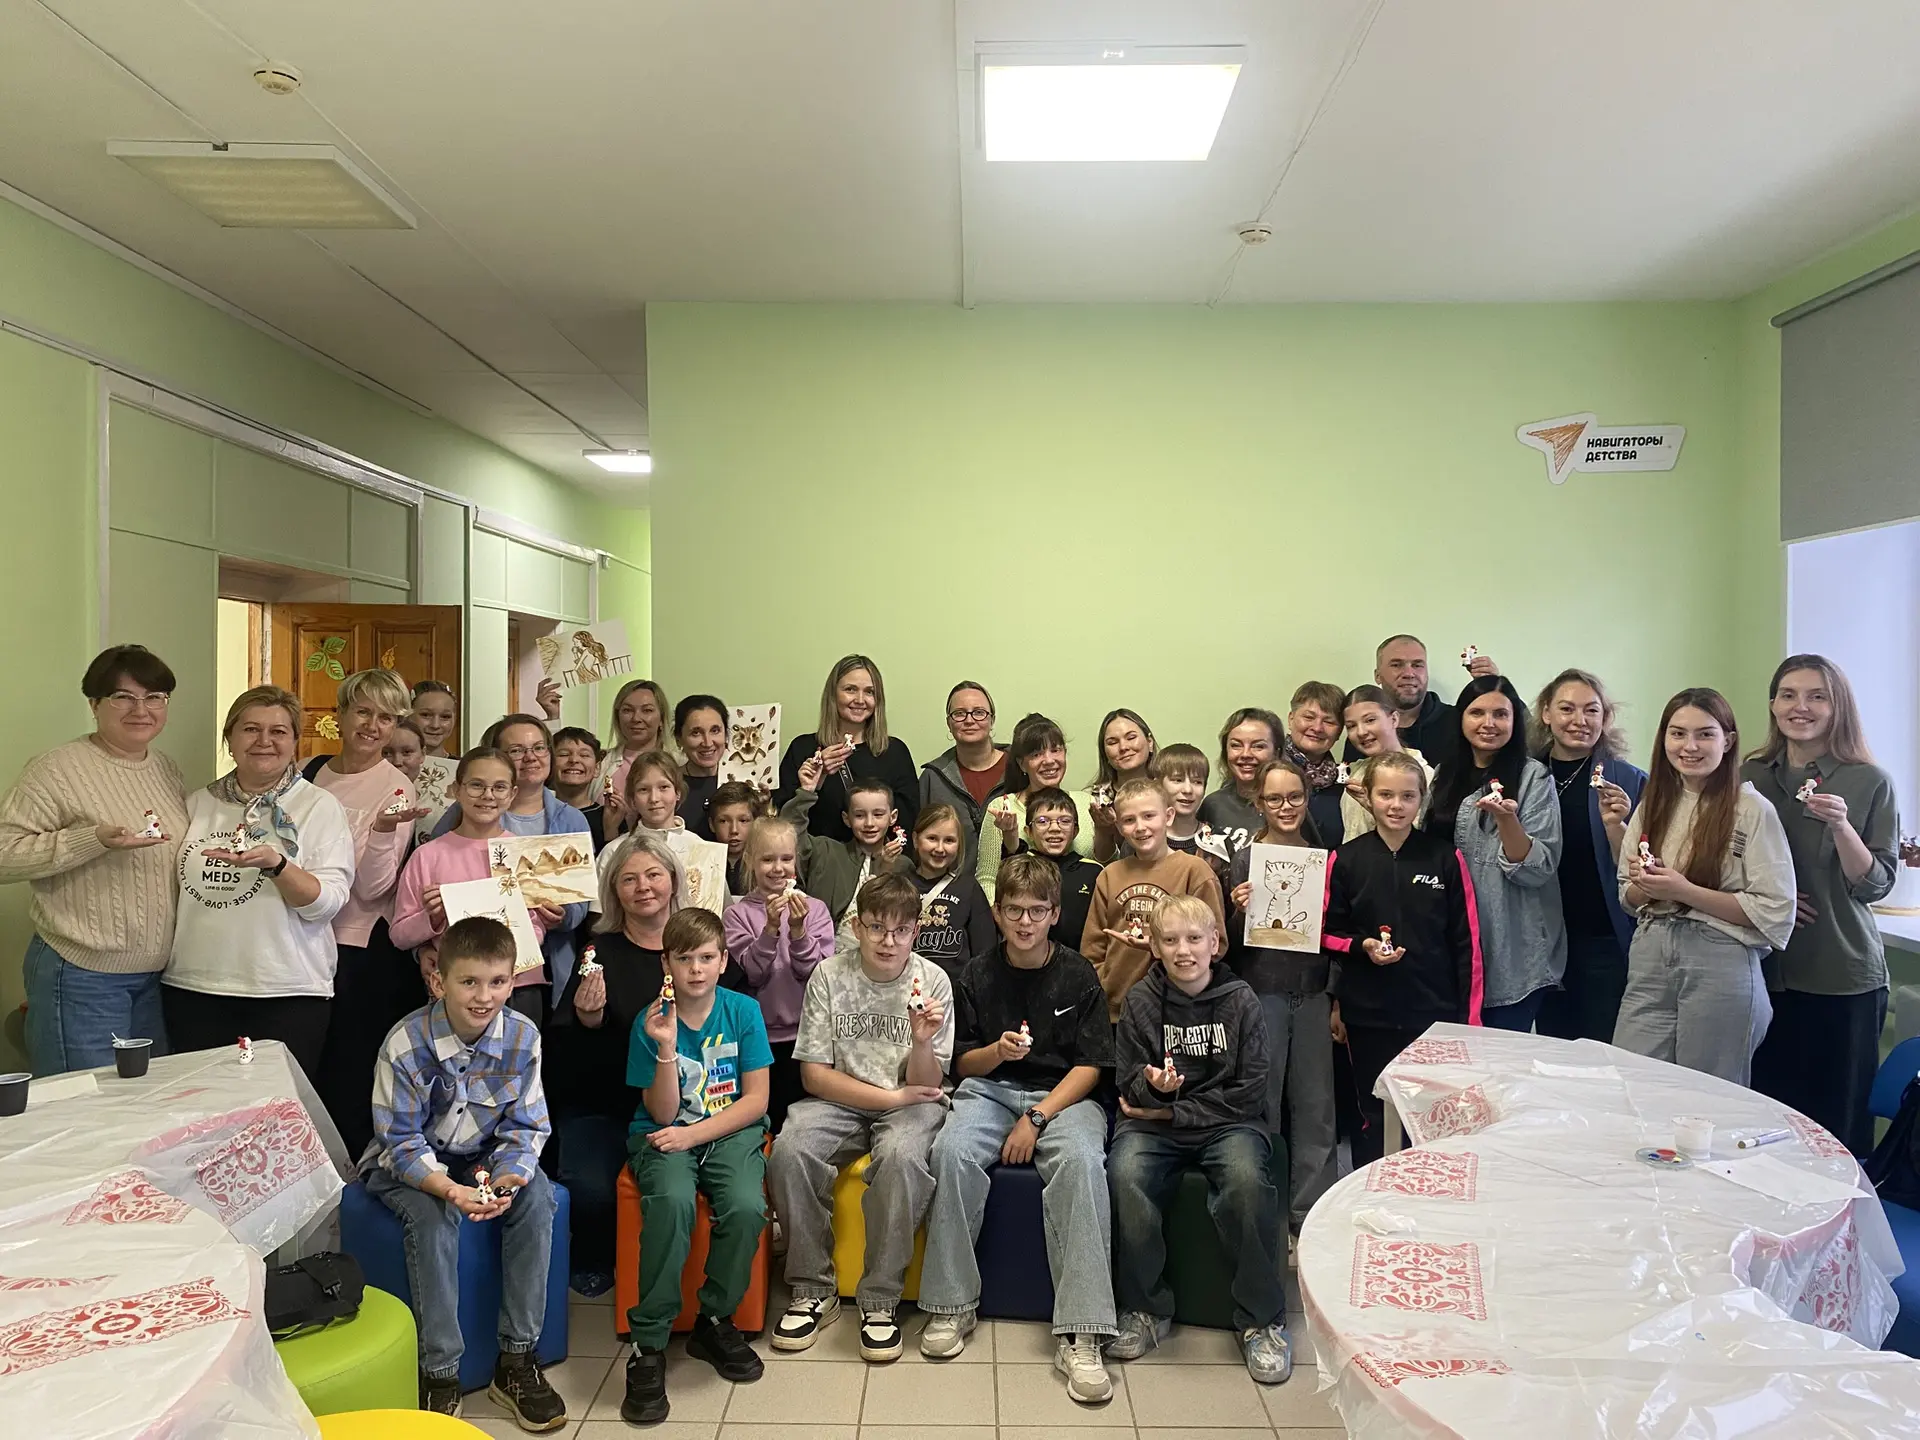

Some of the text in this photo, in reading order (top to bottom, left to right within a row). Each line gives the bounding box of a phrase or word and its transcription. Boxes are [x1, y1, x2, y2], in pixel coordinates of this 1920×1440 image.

[1586, 436, 1664, 449] НАВИГАТОРЫ
[1585, 450, 1638, 463] ДЕТСТВА
[205, 857, 238, 868] BES
[202, 870, 241, 884] MEDS
[1412, 874, 1439, 884] FILA
[184, 885, 203, 902] REST
[935, 893, 949, 901] ALL
[949, 895, 960, 905] ME
[1116, 891, 1131, 906] LET
[1132, 885, 1149, 895] THE
[1130, 899, 1154, 912] BEGIN
[913, 926, 963, 950] aybe
[1181, 1043, 1209, 1056] TIME
